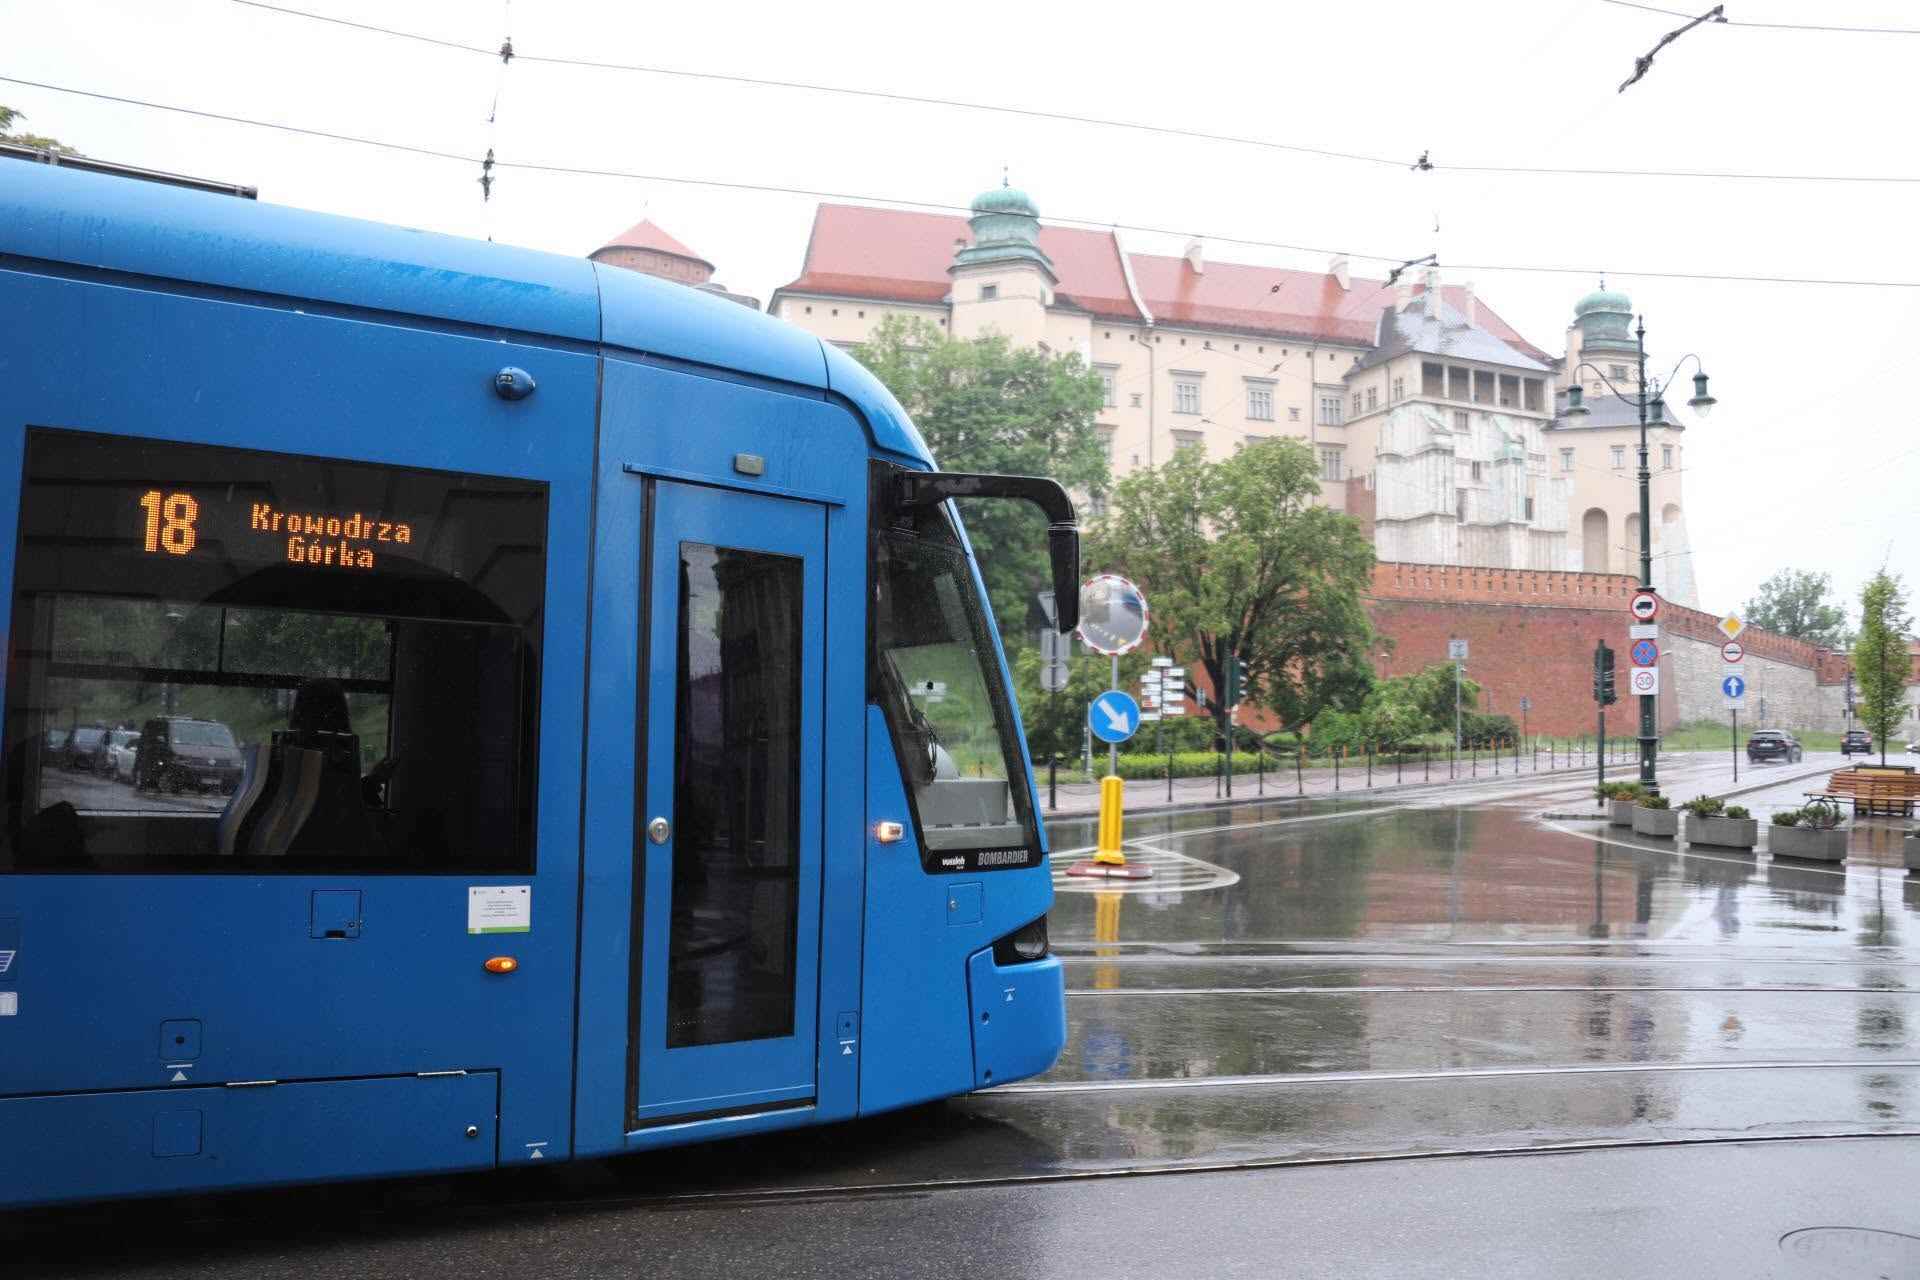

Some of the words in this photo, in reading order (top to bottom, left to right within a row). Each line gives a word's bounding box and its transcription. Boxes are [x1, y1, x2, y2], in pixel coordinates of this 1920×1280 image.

[140, 491, 199, 555] 18
[251, 503, 412, 544] Krowodrza
[287, 535, 374, 568] Górka
[978, 850, 1028, 866] BOMBARDIER
